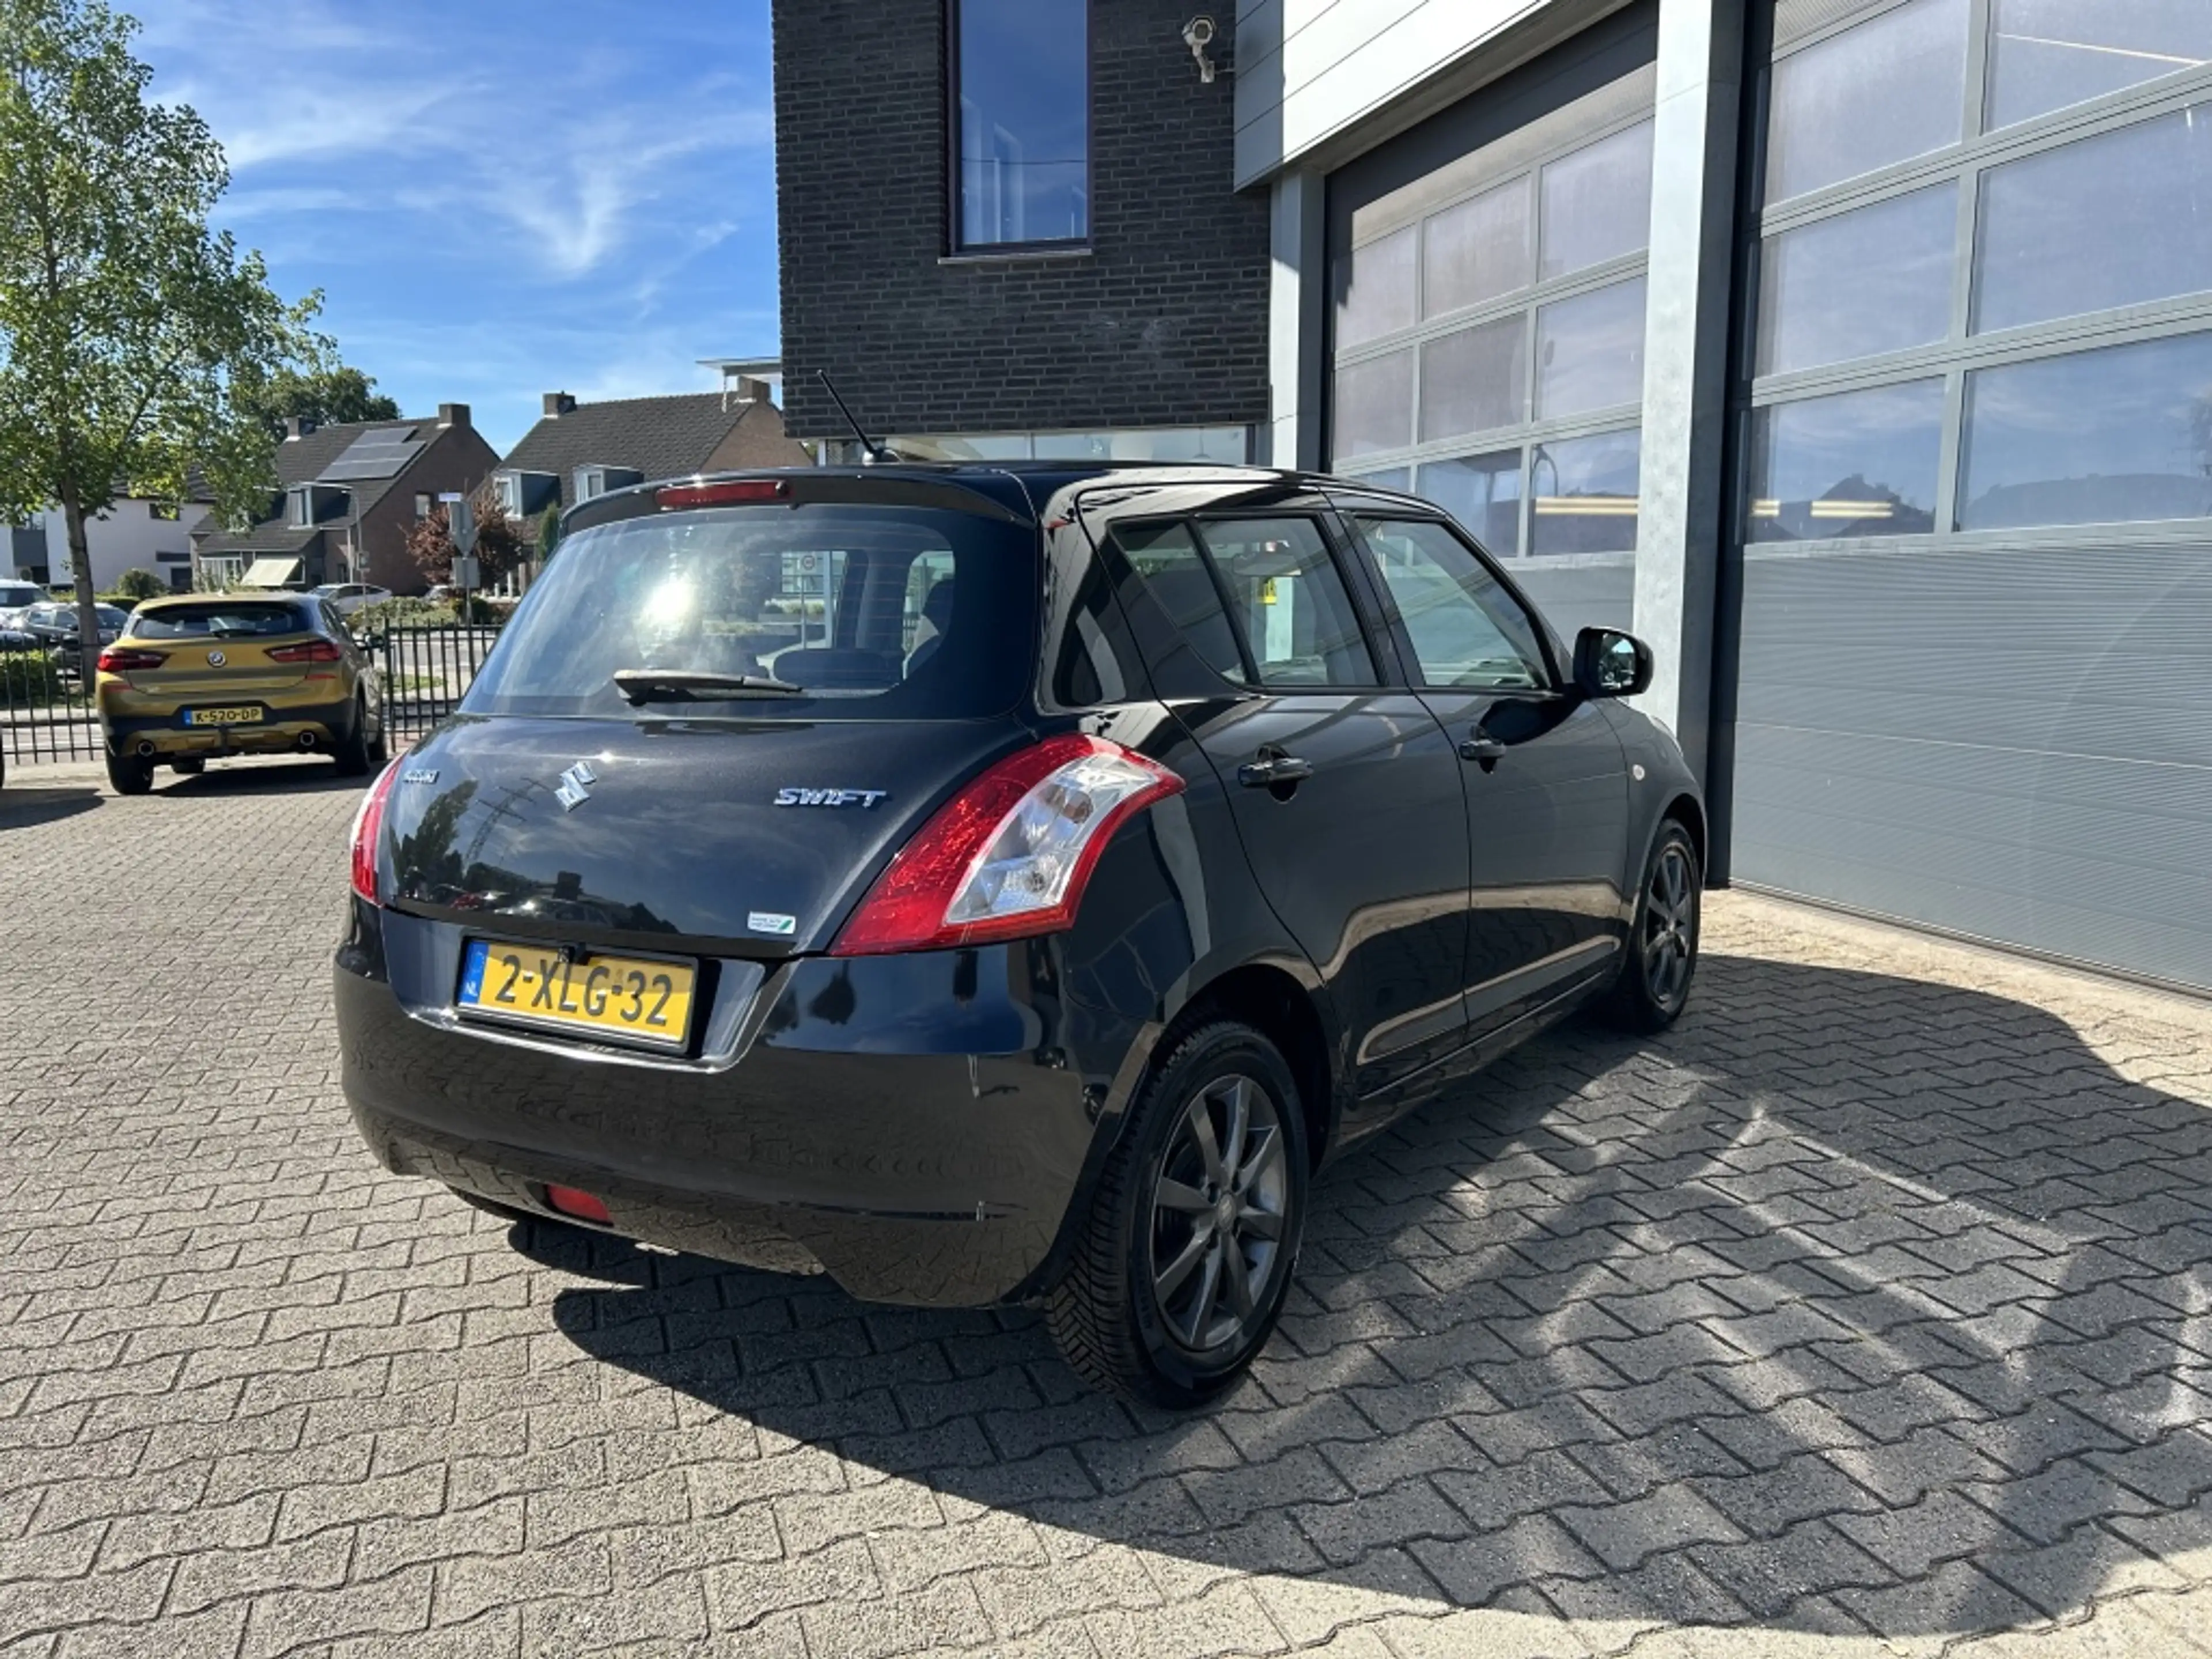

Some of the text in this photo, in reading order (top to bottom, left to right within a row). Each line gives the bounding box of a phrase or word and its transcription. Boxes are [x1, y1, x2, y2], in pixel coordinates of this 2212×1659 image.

[195, 707, 260, 723] K-520-DP
[773, 788, 887, 808] SWIFT
[496, 954, 673, 1027] 2-XLG-32
